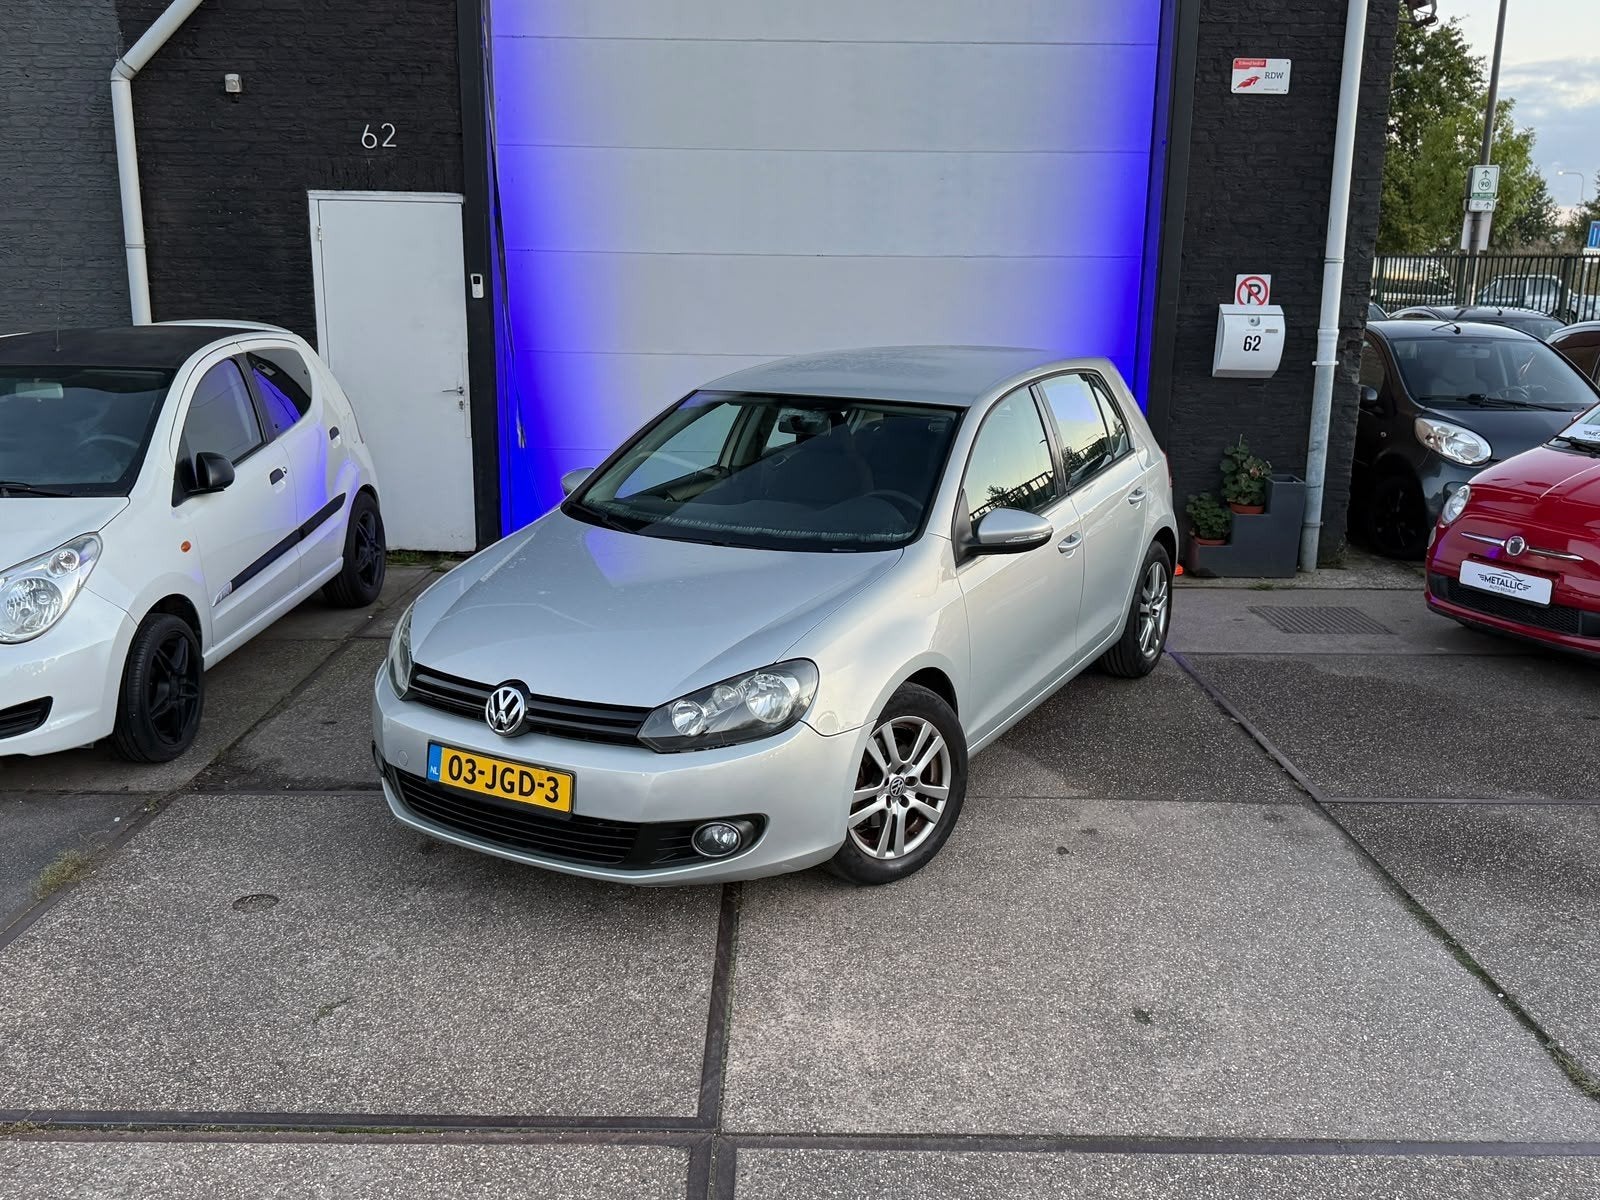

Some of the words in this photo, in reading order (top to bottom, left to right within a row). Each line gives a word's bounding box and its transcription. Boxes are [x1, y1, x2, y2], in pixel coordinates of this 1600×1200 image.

[1264, 71, 1284, 79] RDW
[361, 122, 397, 149] 62
[1243, 335, 1262, 352] 62
[1485, 575, 1524, 591] METALLIC
[429, 765, 439, 776] NL
[448, 754, 559, 803] 03-JGD-3
